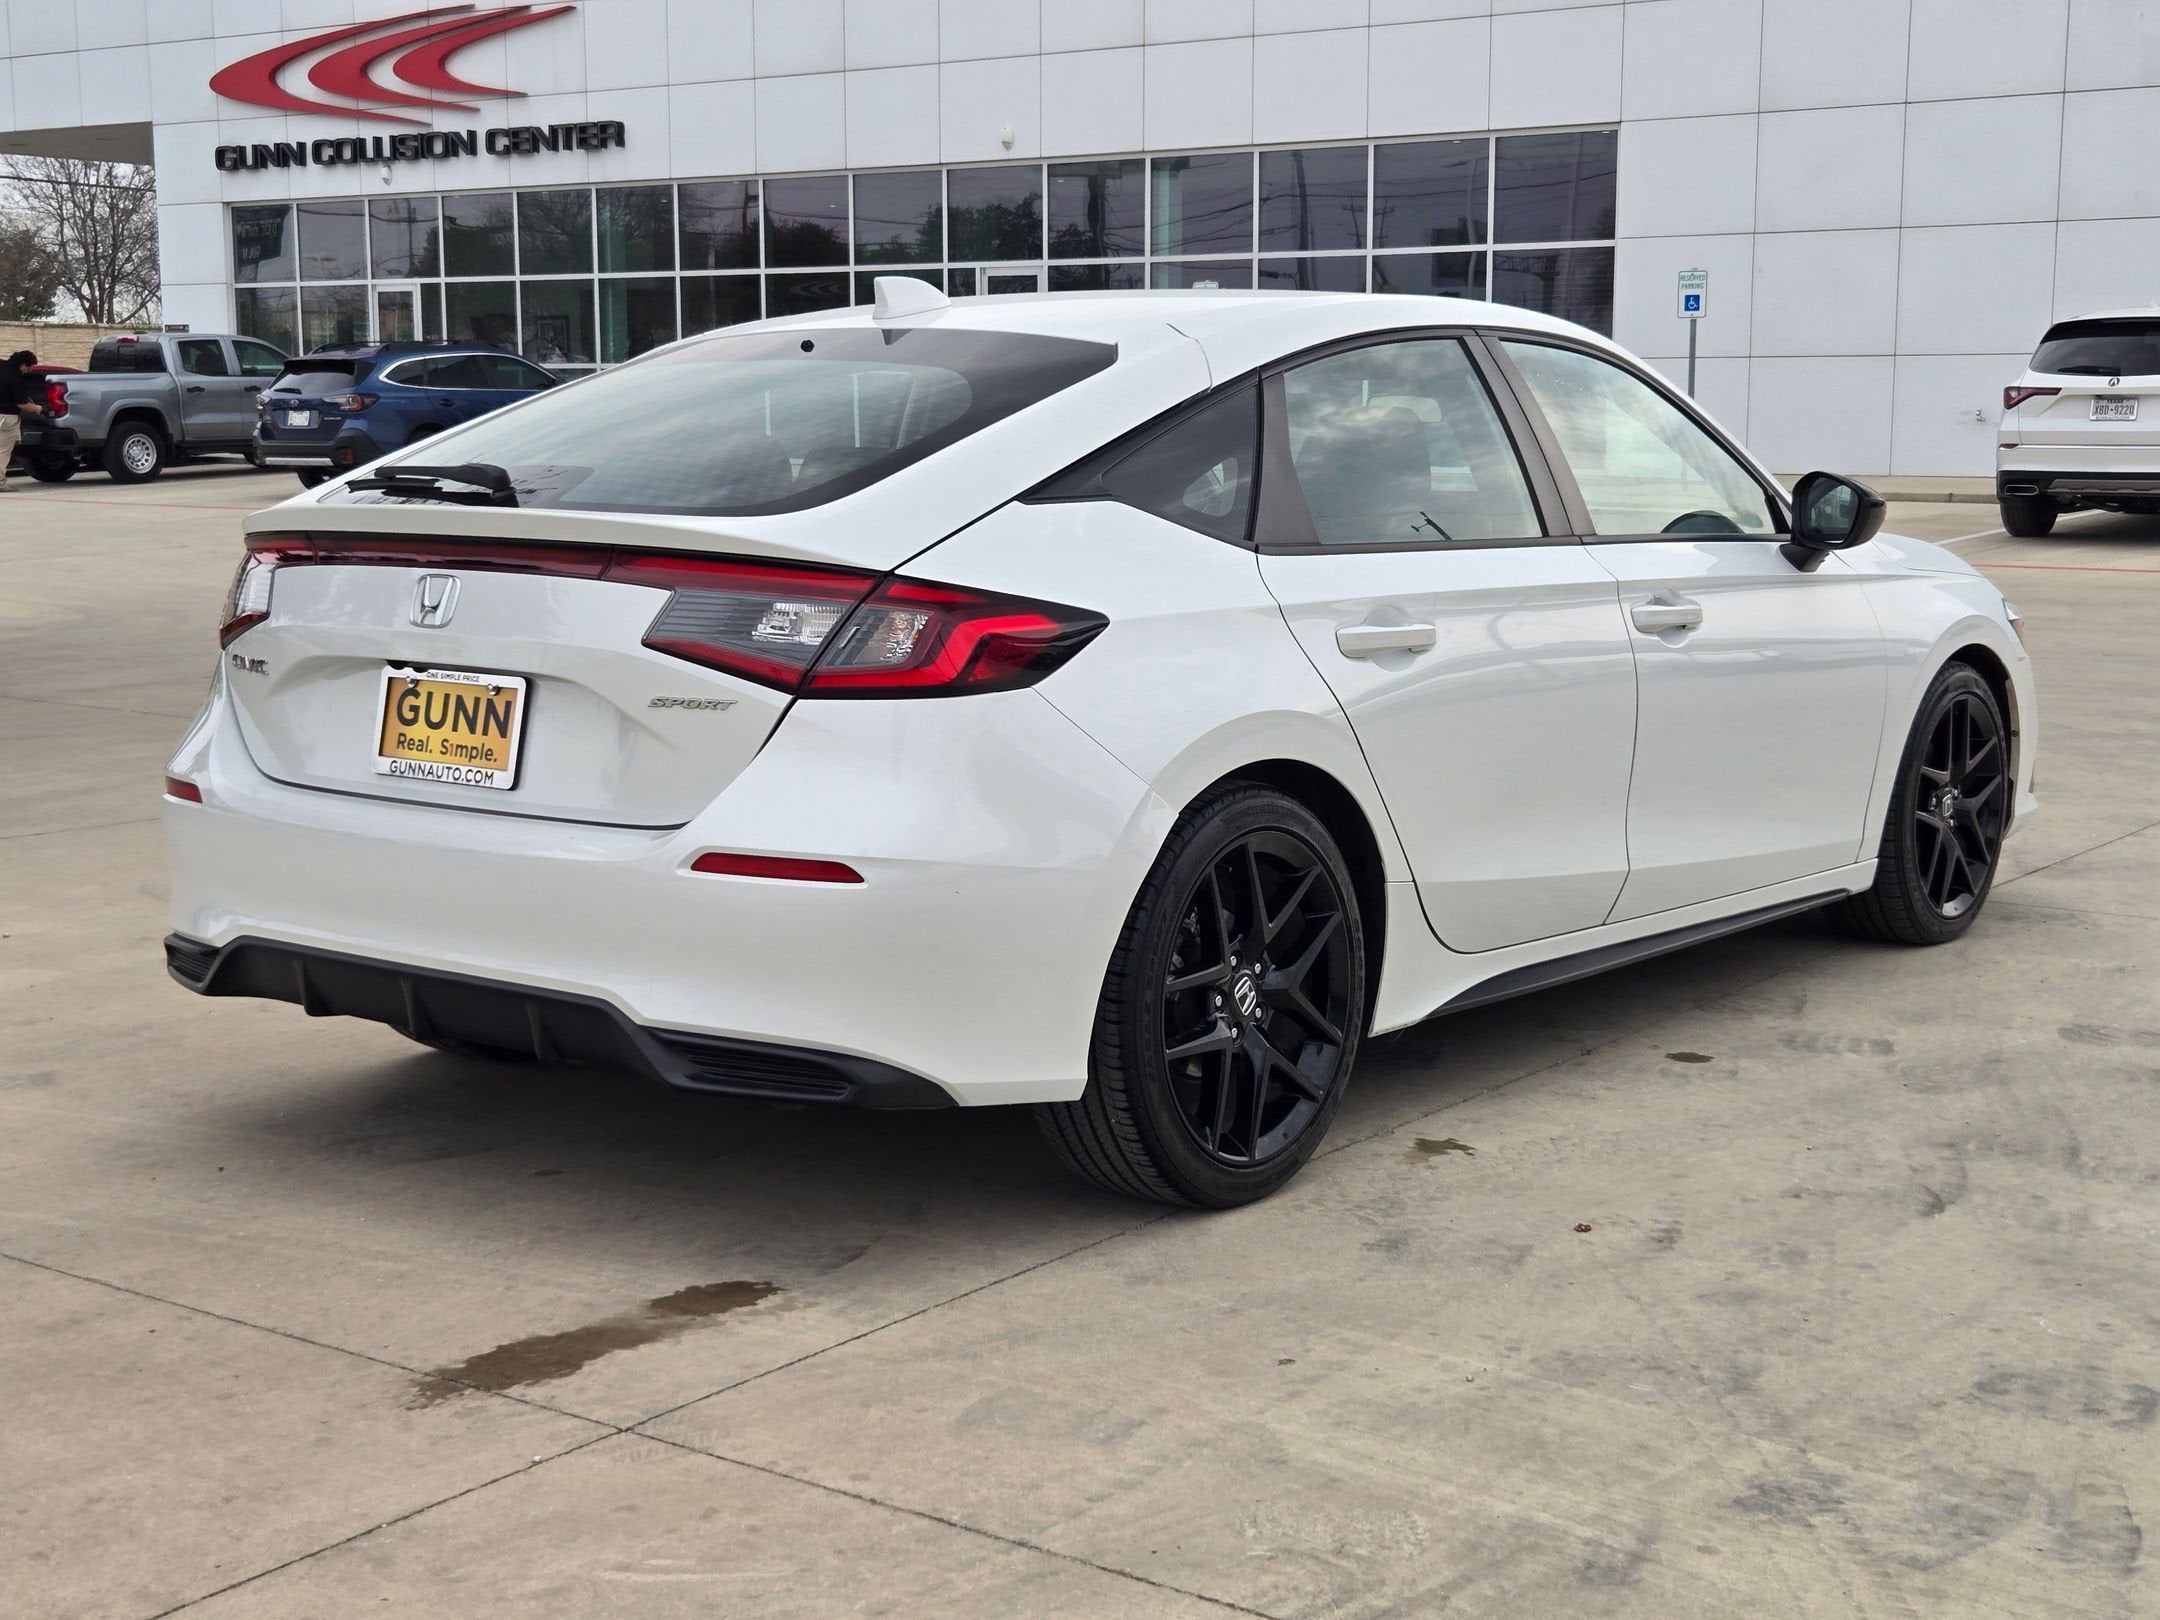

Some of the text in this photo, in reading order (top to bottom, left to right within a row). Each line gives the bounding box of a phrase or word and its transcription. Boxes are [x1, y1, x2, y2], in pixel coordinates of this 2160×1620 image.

[215, 121, 625, 171] GUNN COLLISION CENTER
[426, 671, 480, 683] ONE SIMPLE PRICE
[396, 688, 512, 739] GUNN
[647, 696, 738, 711] SPORT
[396, 732, 433, 754] Real.
[389, 759, 494, 786] GUNNAUTO.COM
